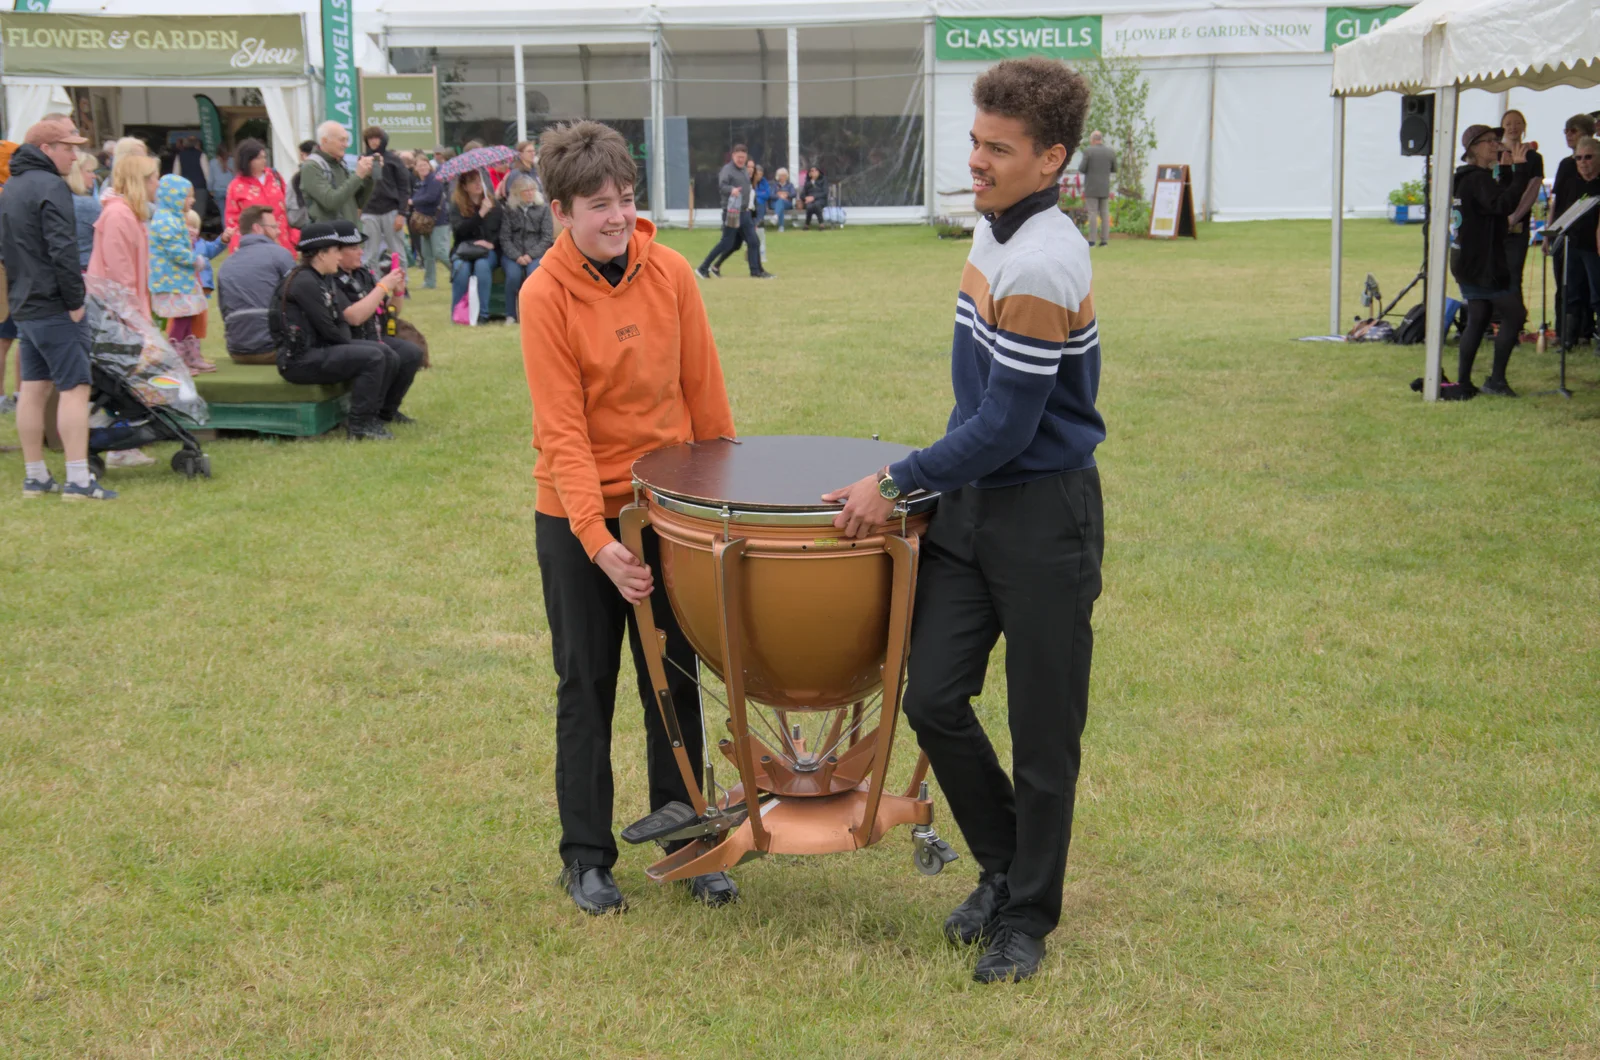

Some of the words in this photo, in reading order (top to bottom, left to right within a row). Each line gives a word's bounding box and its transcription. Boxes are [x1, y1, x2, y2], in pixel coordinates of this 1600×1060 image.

[946, 27, 1092, 49] GLASSWELLS
[1115, 27, 1177, 42] FLOWER
[1182, 26, 1191, 39] &
[1196, 24, 1260, 40] GARDEN
[1265, 23, 1313, 37] SHOW
[1336, 17, 1393, 38] GLA
[6, 27, 107, 49] FLOWER
[108, 30, 131, 49] &
[133, 29, 239, 49] GARDEN
[230, 37, 299, 68] Show
[331, 0, 353, 147] LASSWELLS
[367, 116, 433, 127] GLASSWELLS
